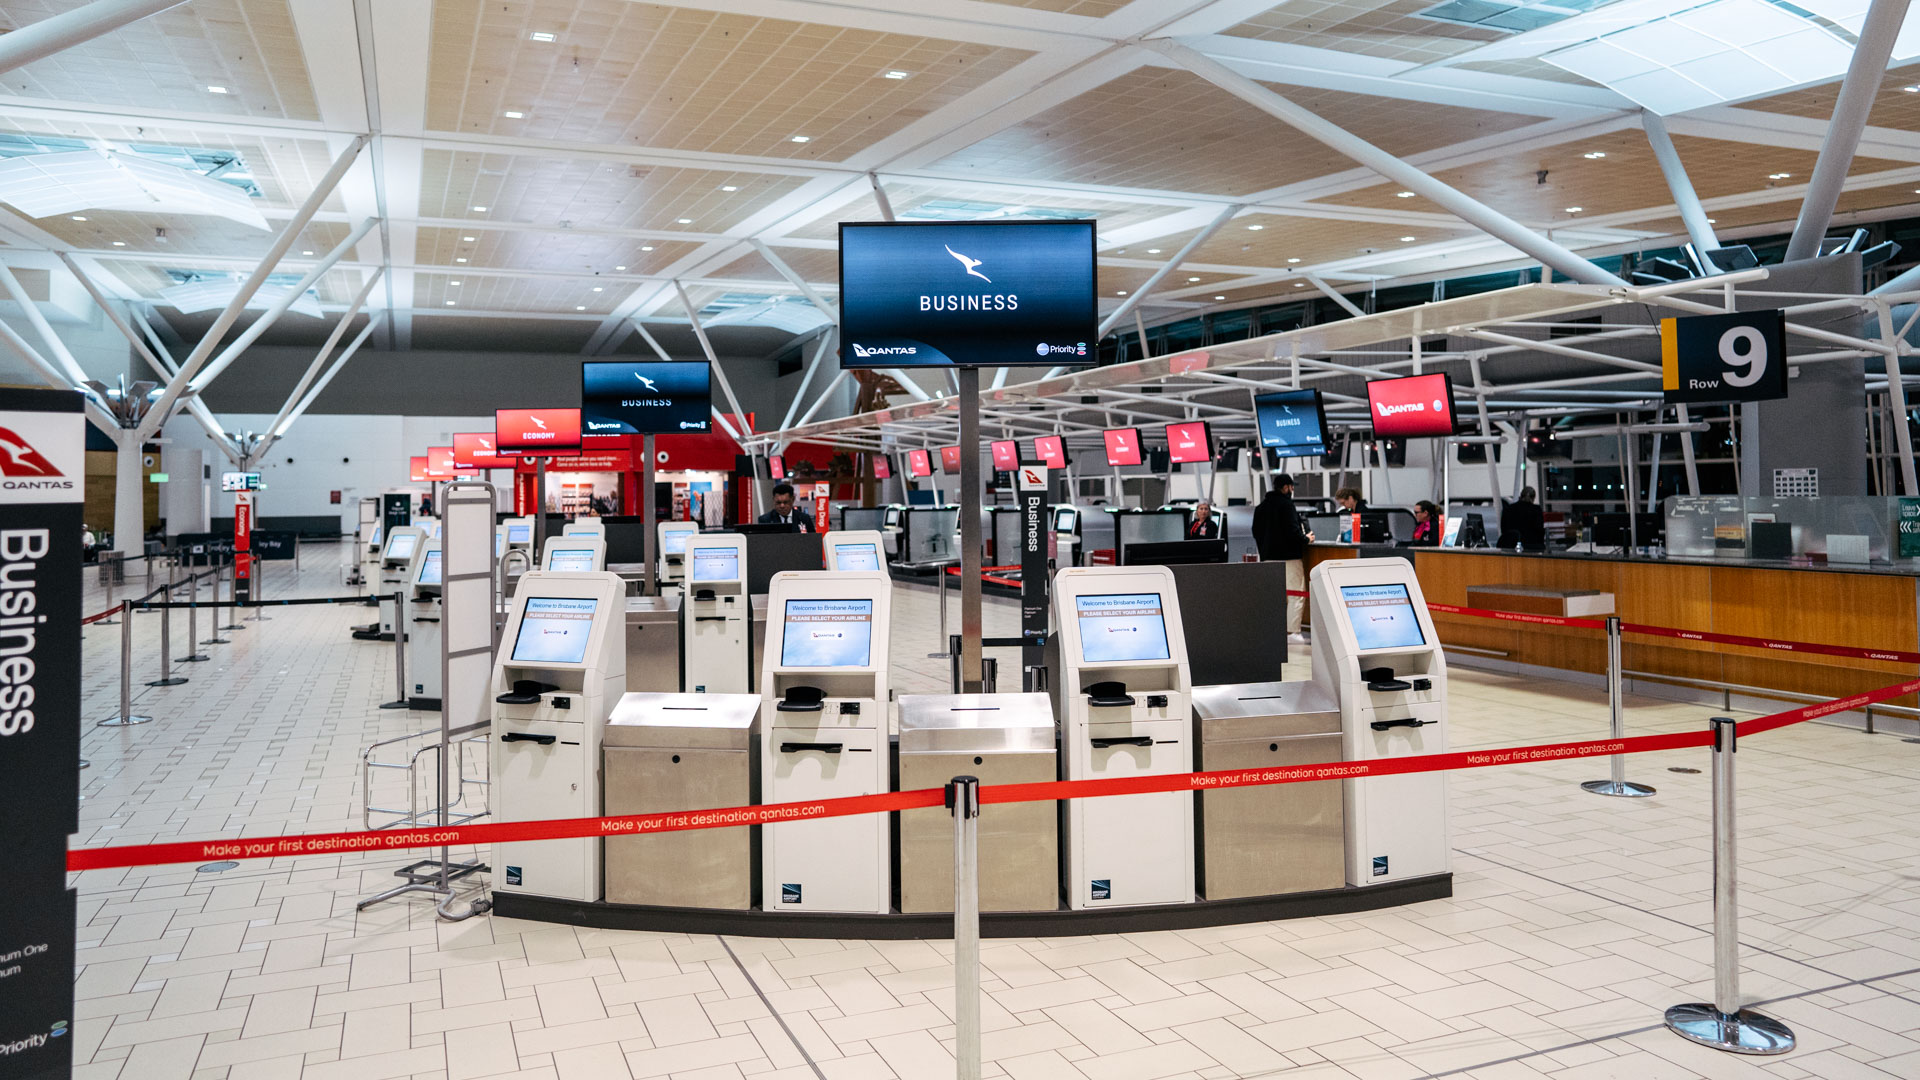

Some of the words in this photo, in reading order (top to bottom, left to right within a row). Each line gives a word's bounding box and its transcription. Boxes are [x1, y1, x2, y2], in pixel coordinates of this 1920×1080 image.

[920, 294, 1018, 311] BUSINESS
[867, 347, 917, 355] QANTAS
[1050, 345, 1076, 354] Priority
[1718, 325, 1768, 388] 9
[1689, 379, 1719, 389] Row
[1388, 402, 1424, 413] QANTAS
[522, 432, 555, 440] ECONOMY
[3, 481, 74, 489] QANTAS
[237, 506, 247, 537] Economy
[1028, 496, 1040, 552] Business
[0, 528, 50, 738] Business
[1870, 652, 1899, 660] QANTAS
[1467, 754, 1490, 764] Make
[1492, 752, 1510, 764] your
[1512, 750, 1528, 760] first
[1530, 746, 1576, 759] destination
[1578, 743, 1624, 755] qantas.com
[1190, 775, 1217, 786] Make
[1219, 774, 1240, 786] your
[1242, 772, 1260, 782] first
[1262, 768, 1314, 781] destination
[1317, 765, 1369, 778] qantas.com
[601, 819, 633, 832] Make
[637, 818, 662, 832] your
[666, 815, 688, 827] first
[691, 810, 756, 826] destination
[759, 804, 825, 821] qantas.com
[203, 844, 241, 856] Make
[244, 843, 275, 856] your
[278, 839, 303, 852] first
[306, 835, 381, 850] destination
[385, 831, 459, 847] qantas.com
[24, 943, 49, 956] One
